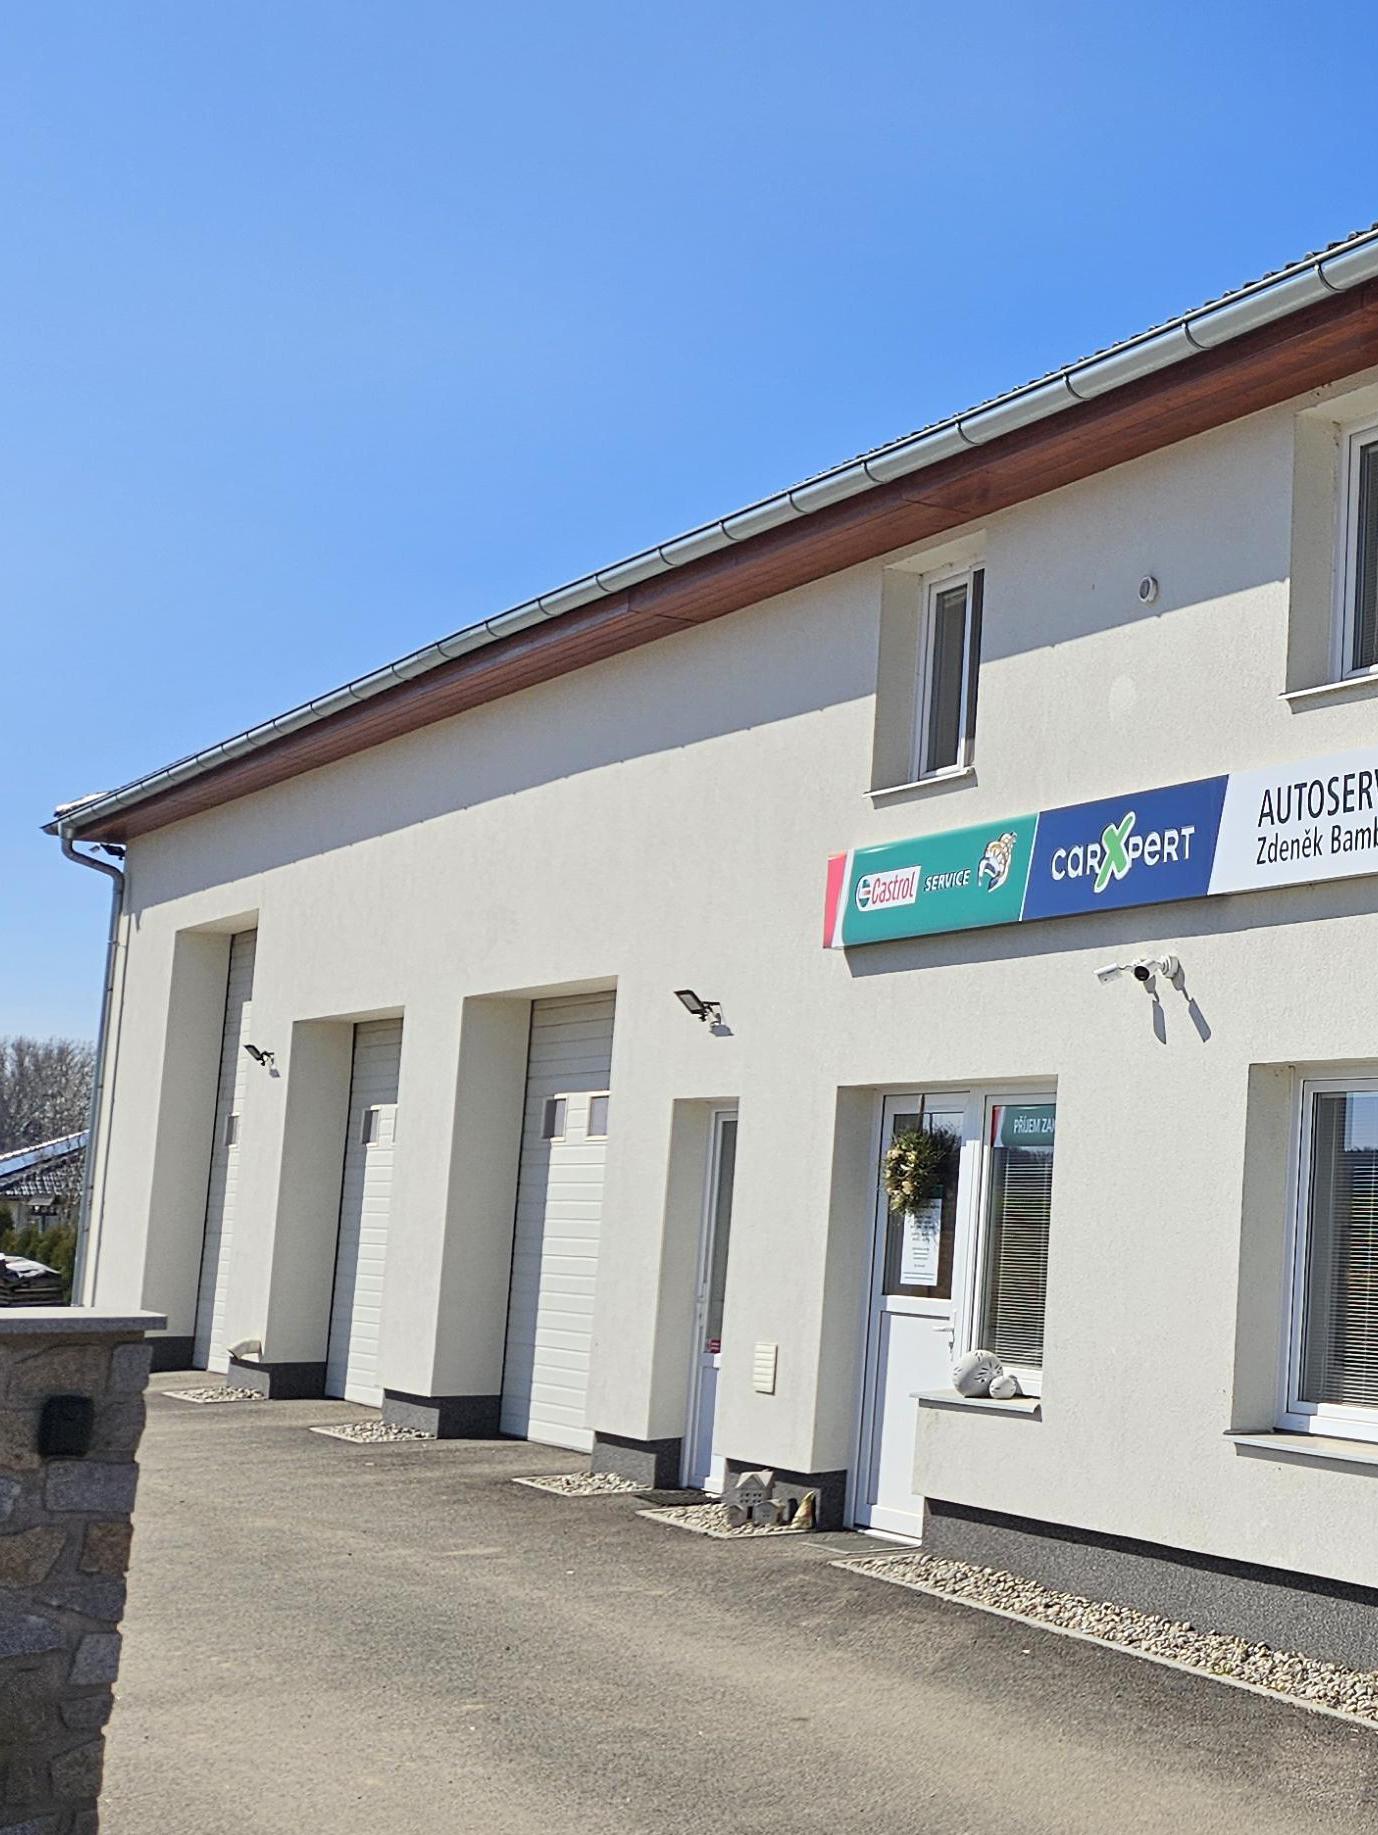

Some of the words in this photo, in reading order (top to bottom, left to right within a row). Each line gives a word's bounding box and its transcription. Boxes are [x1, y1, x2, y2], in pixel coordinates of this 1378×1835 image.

[1256, 826, 1323, 865] Zdeněk
[871, 870, 916, 905] Castrol
[924, 868, 972, 892] SERVICE
